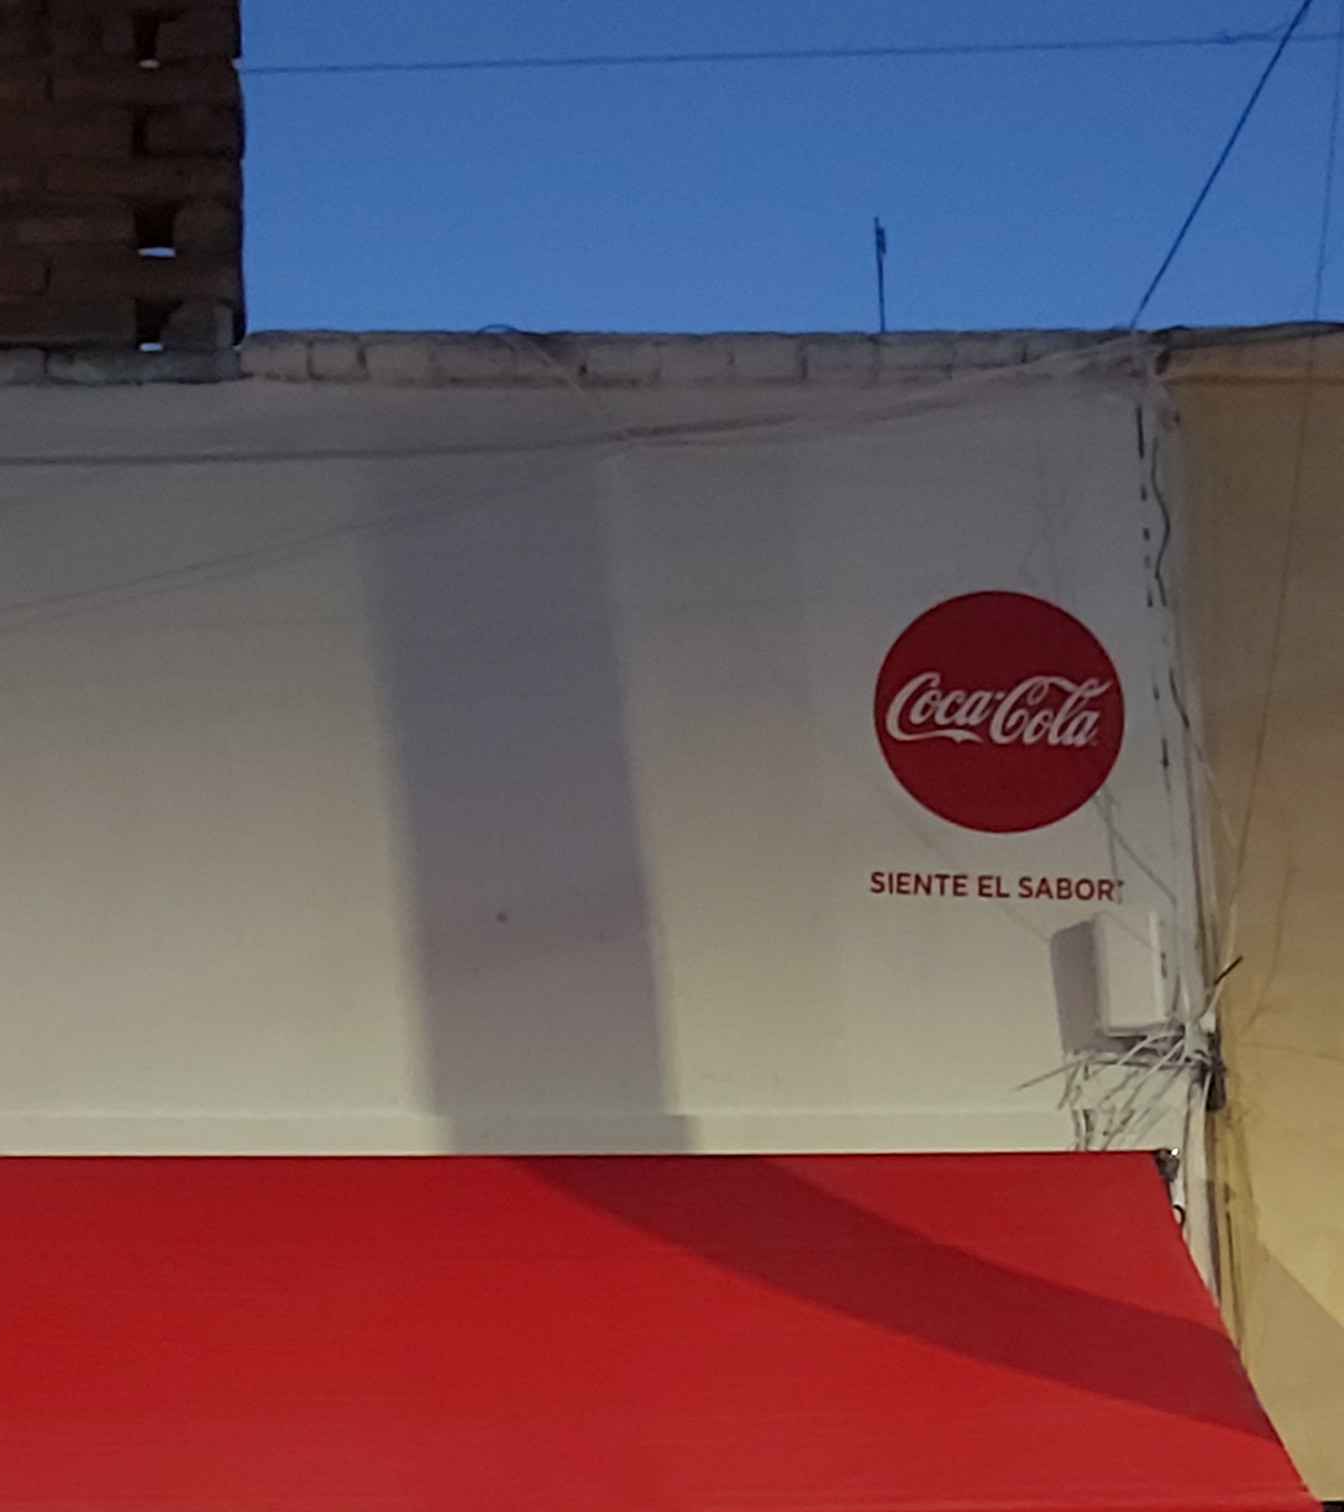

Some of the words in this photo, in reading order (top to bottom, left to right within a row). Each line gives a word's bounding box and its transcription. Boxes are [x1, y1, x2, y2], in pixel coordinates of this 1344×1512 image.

[885, 671, 1114, 748] Coca-Cola
[869, 870, 969, 898] SIENTE
[977, 874, 1011, 899] EL
[1017, 876, 1116, 901] SABOR
